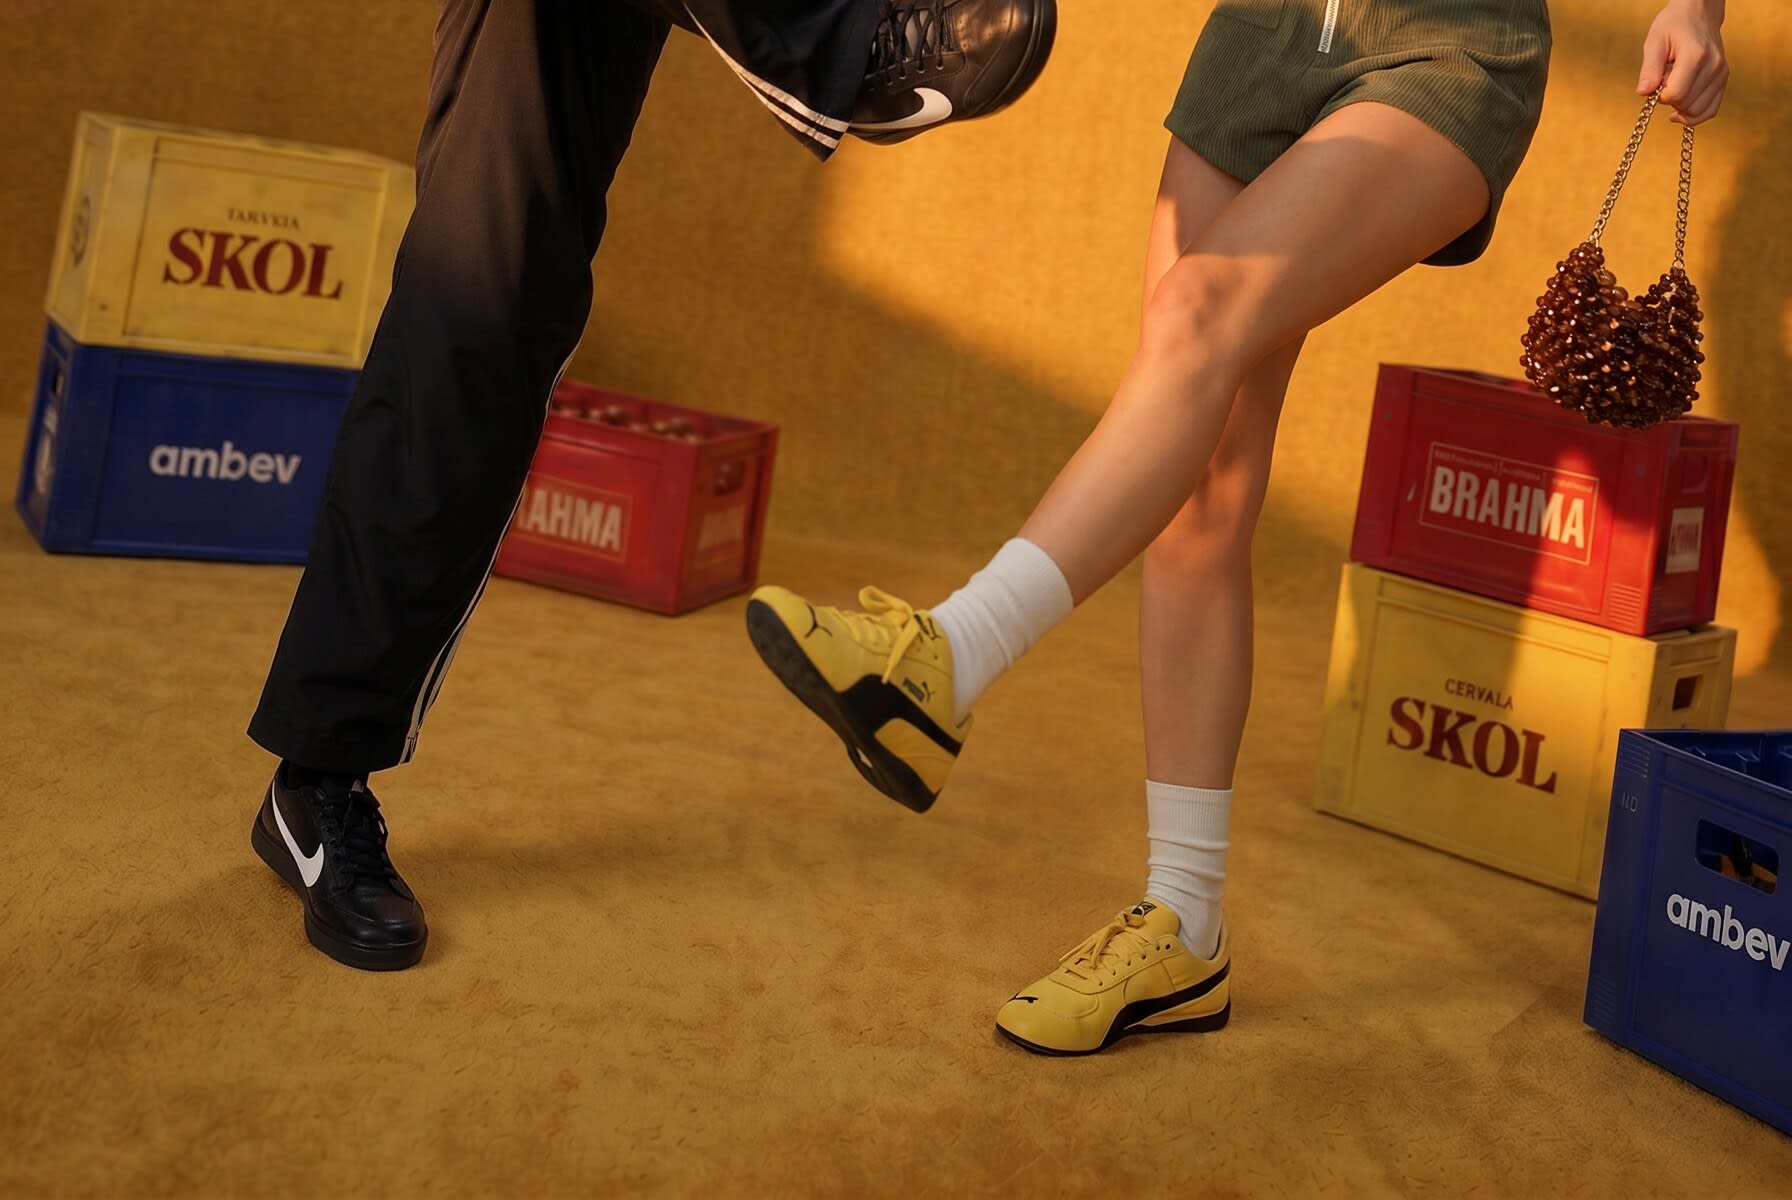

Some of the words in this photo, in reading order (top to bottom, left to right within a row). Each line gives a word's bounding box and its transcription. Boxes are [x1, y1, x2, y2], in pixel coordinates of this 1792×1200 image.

[162, 227, 344, 300] SKOL
[149, 440, 302, 484] ambev
[516, 488, 621, 552] AHMA
[1429, 465, 1585, 548] BRAHMA
[1445, 678, 1513, 711] CERVALA
[1387, 696, 1557, 794] SKOL
[1666, 893, 1791, 971] ambev
